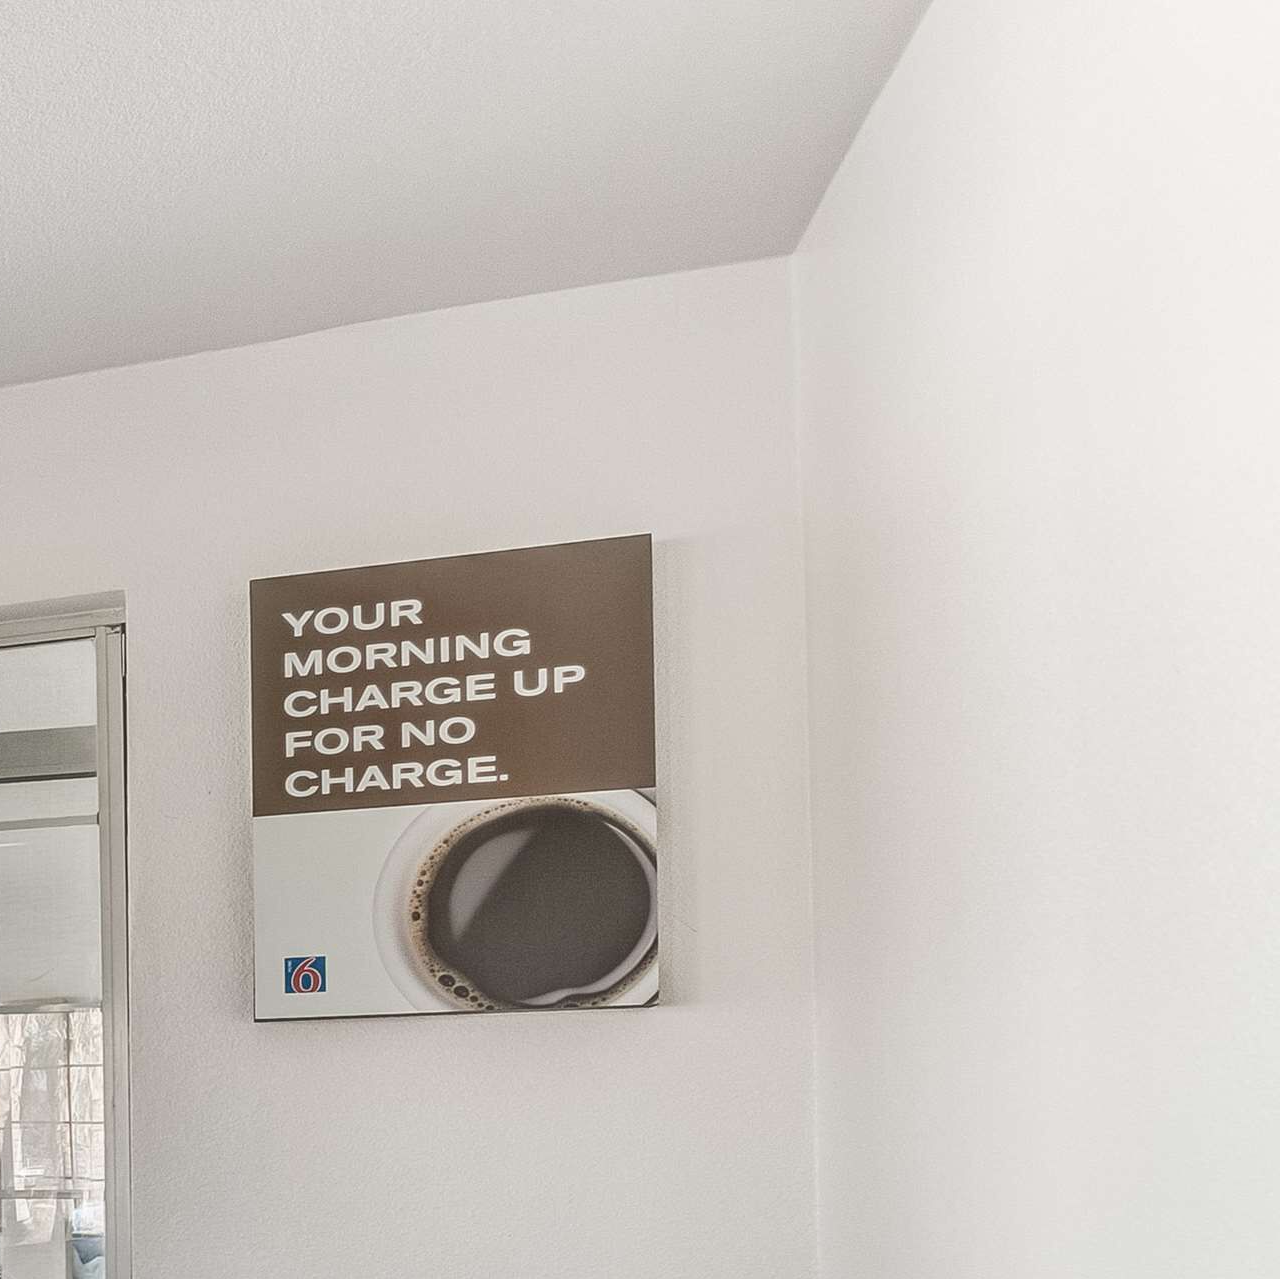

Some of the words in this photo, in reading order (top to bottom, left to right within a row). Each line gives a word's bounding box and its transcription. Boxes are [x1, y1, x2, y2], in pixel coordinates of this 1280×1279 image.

[281, 599, 423, 637] YOUR
[284, 628, 531, 678] MORNING
[283, 673, 496, 718] CHARGE
[513, 665, 586, 697] UP
[285, 724, 385, 758] FOR
[401, 717, 476, 748] NO
[284, 755, 509, 798] CHARGE.
[290, 956, 322, 993] 6
